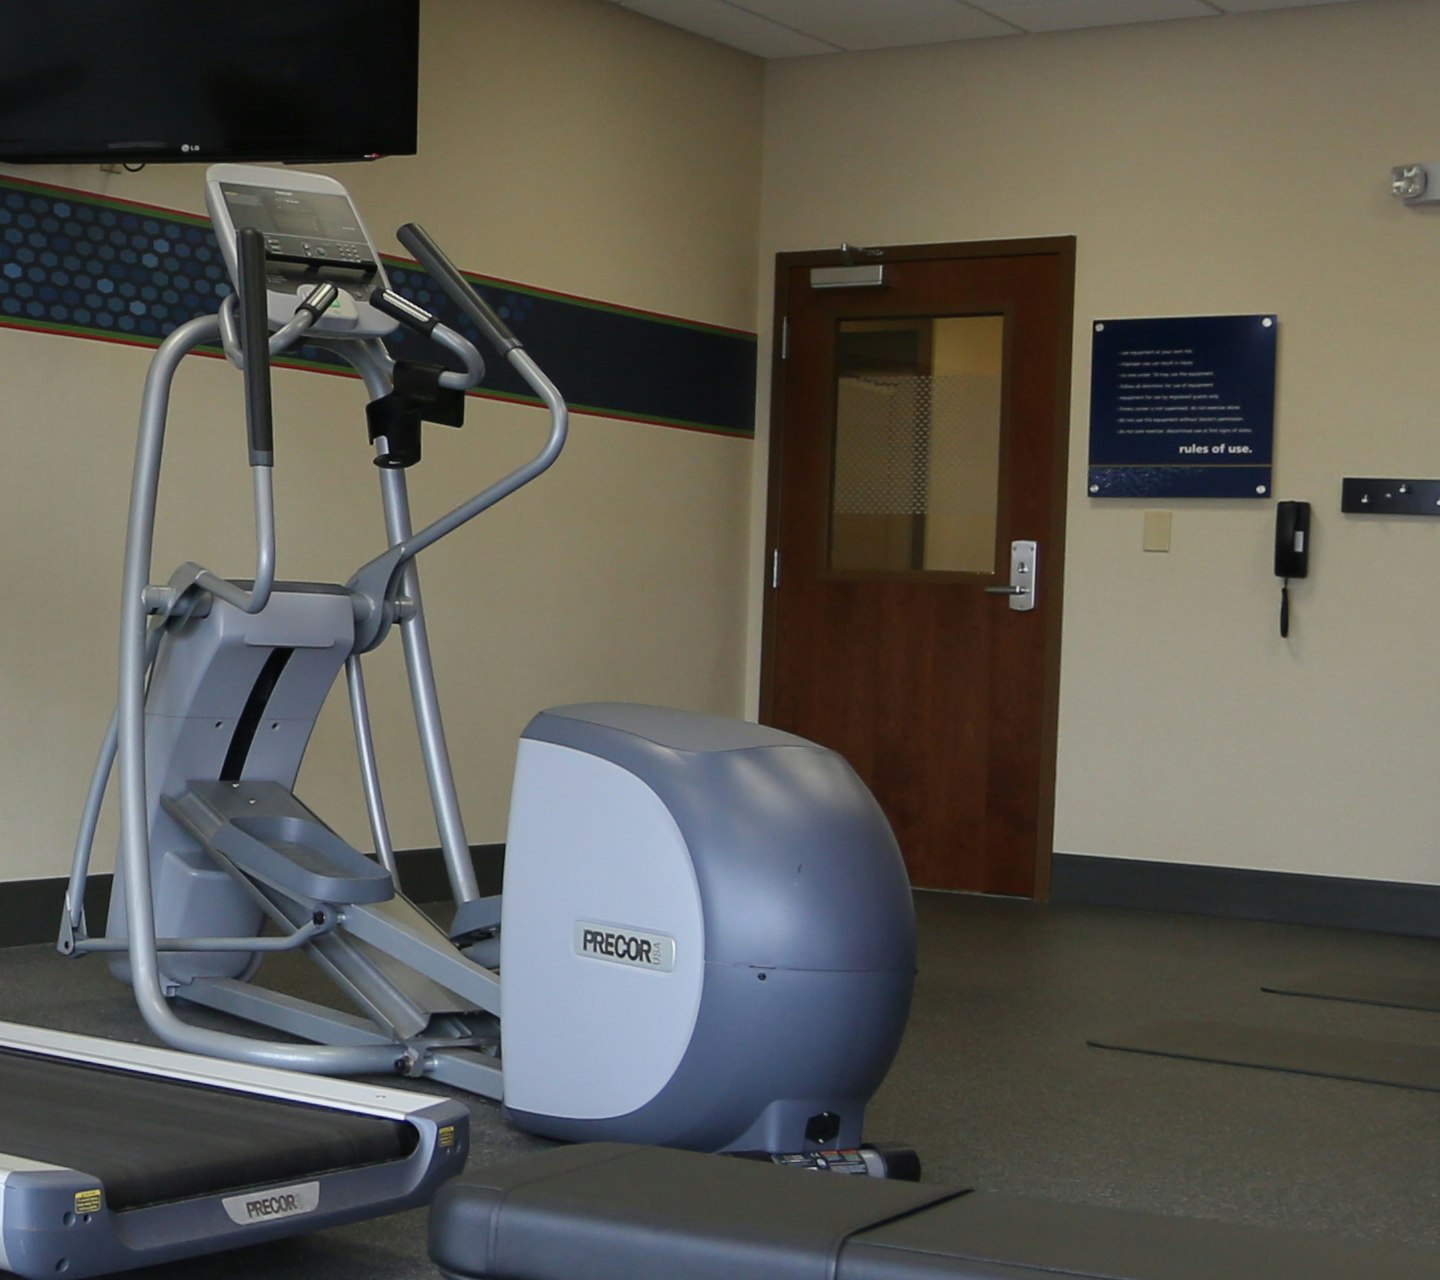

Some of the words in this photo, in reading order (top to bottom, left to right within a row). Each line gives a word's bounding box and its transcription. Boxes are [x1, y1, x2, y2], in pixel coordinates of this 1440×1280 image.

[1179, 443, 1209, 454] rules
[1211, 443, 1226, 454] of
[1228, 445, 1253, 454] use.
[583, 929, 652, 964] PRECOR
[245, 1194, 298, 1218] PRECOR
